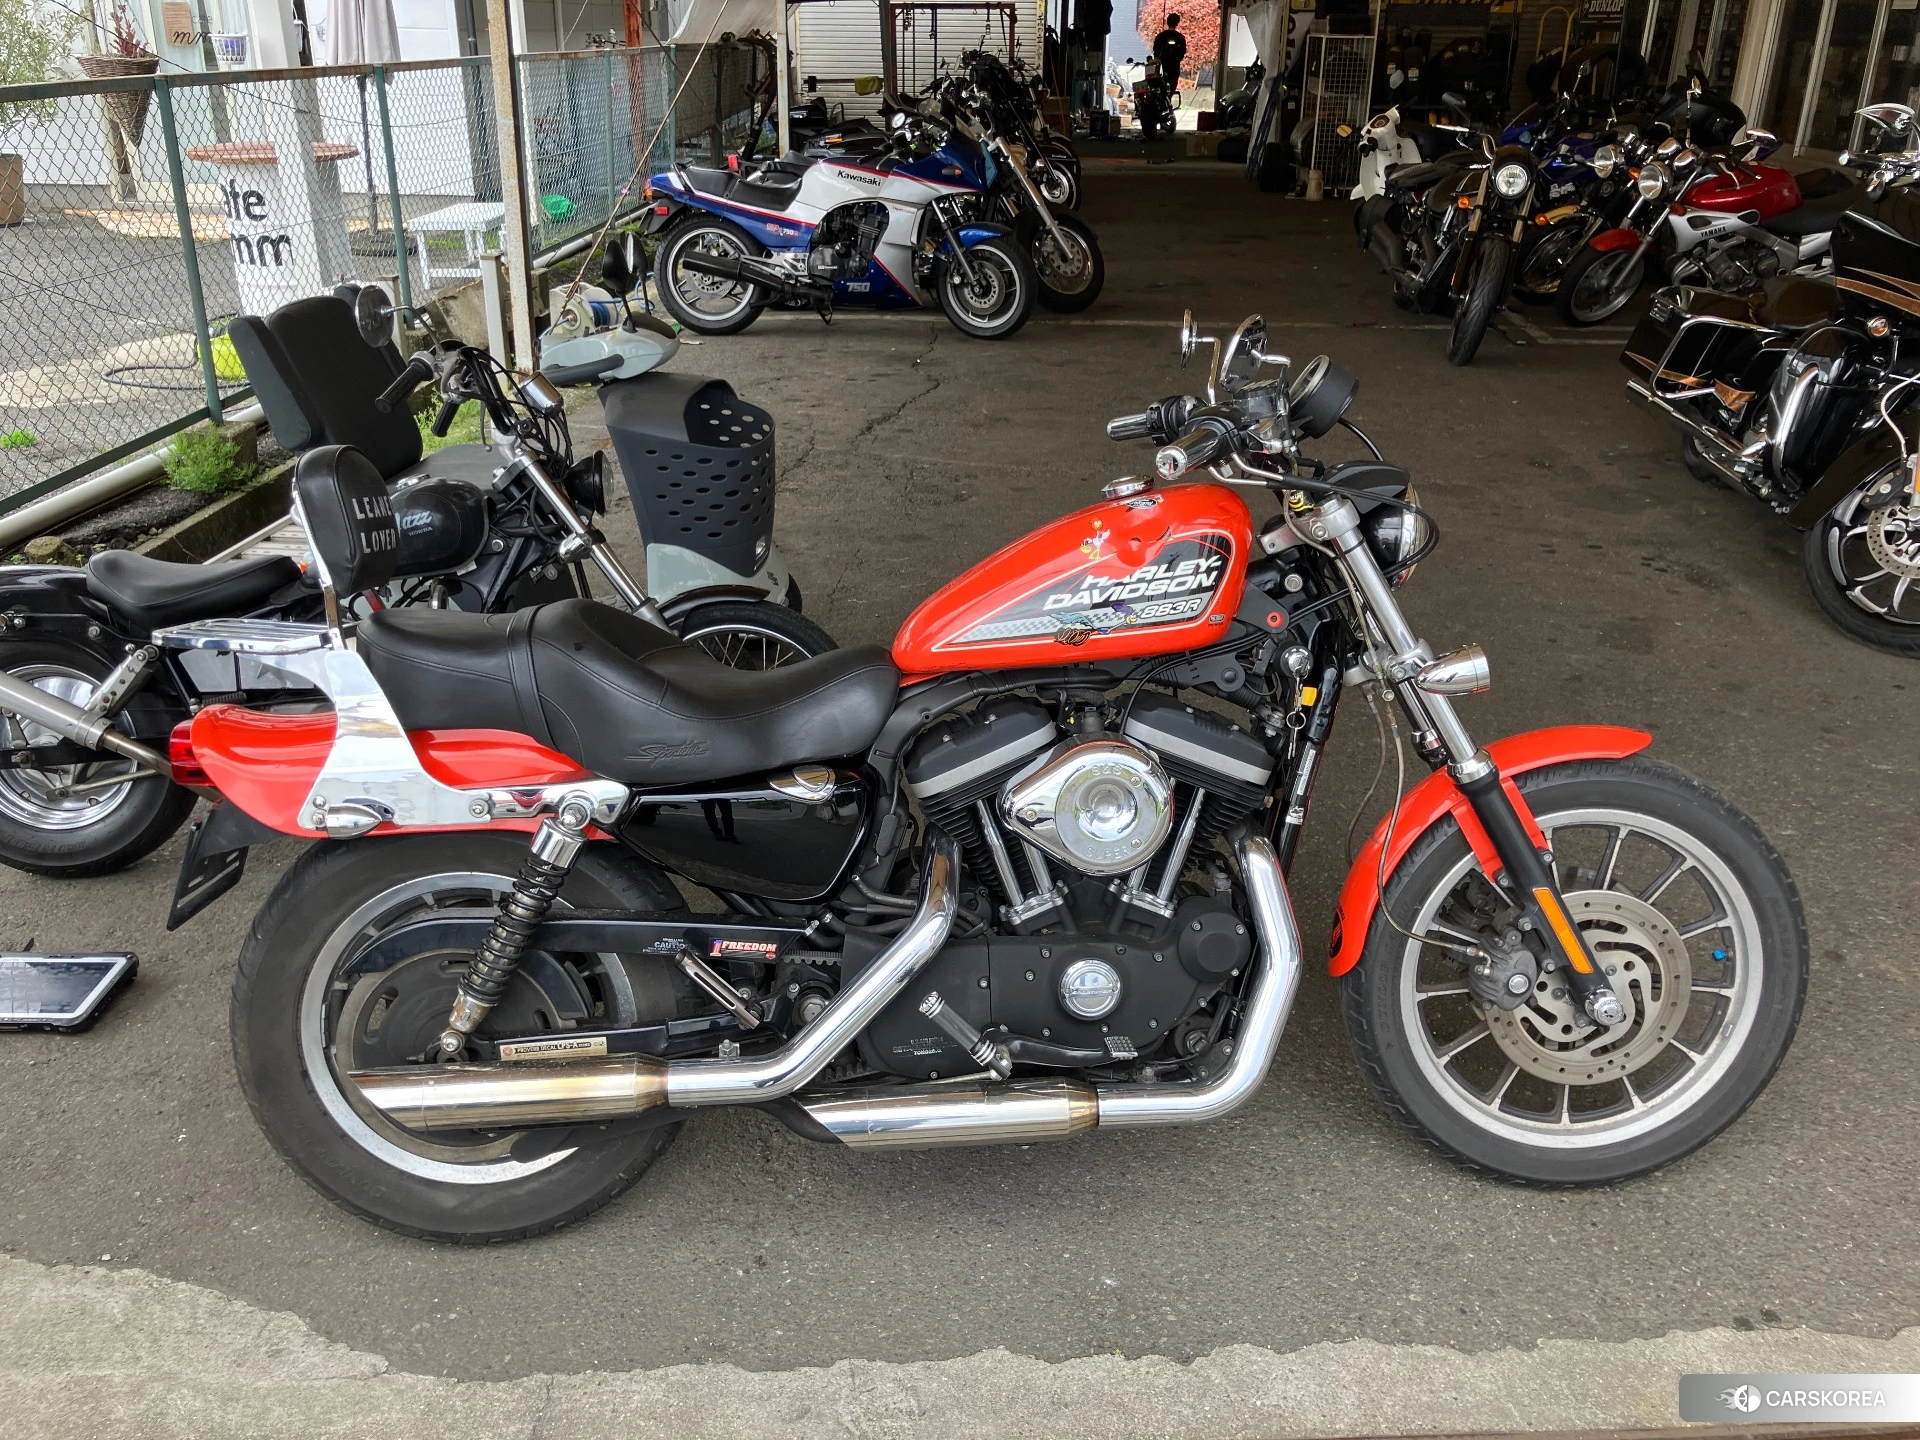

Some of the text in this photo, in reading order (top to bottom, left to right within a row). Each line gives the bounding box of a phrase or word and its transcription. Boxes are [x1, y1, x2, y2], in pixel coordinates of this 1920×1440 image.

[1588, 0, 1624, 12] DUNLOP
[837, 169, 881, 187] Kawasaki
[1700, 226, 1727, 238] YAMAHA
[846, 282, 870, 292] 750
[408, 526, 434, 537] HONDA
[360, 529, 397, 554] LOVER
[1043, 571, 1215, 610] DAVIDSON
[1140, 597, 1202, 620] 883R
[1091, 764, 1123, 776] S&S
[1085, 845, 1131, 860] SUPER
[654, 941, 691, 950] CAUTIO
[721, 940, 777, 953] FREEDOM
